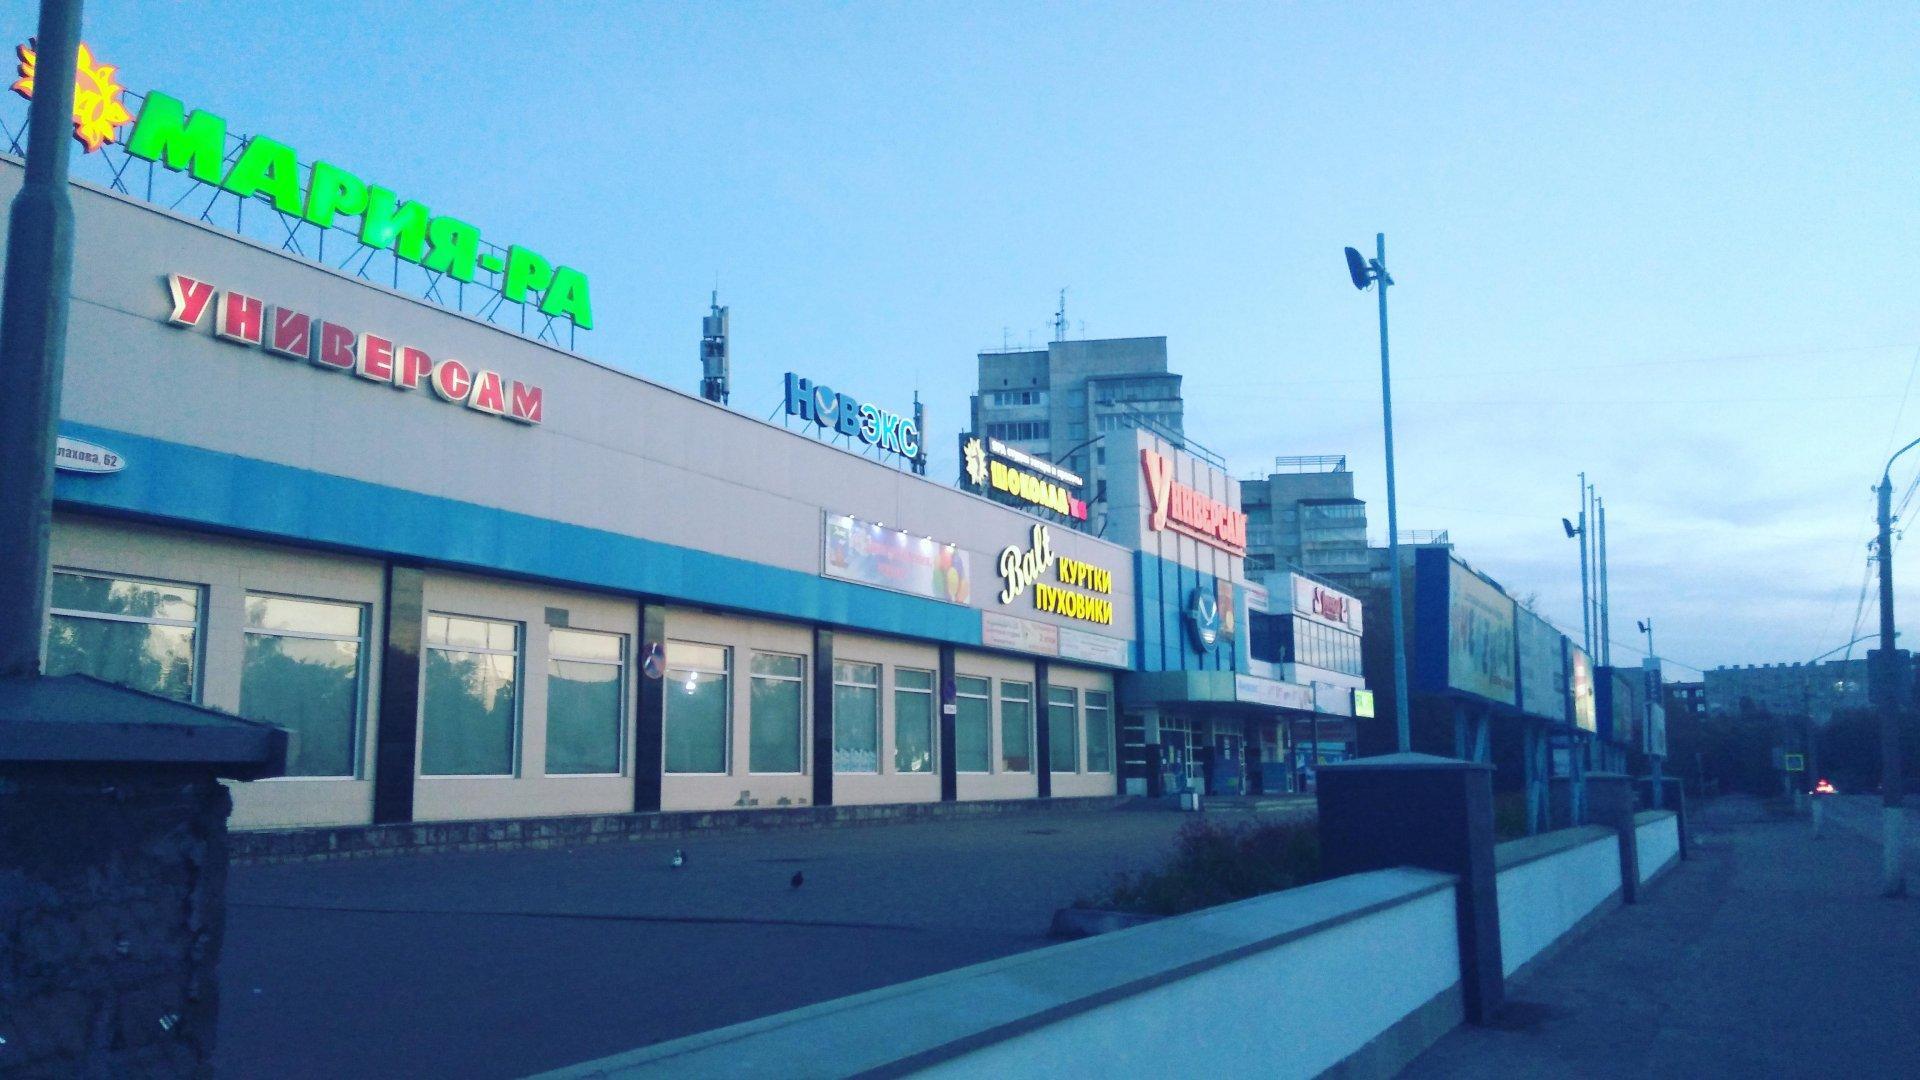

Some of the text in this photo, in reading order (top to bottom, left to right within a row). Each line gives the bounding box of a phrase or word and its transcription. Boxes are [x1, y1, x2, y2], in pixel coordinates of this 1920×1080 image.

[124, 89, 594, 331] МАРИЯ-РА
[168, 273, 543, 425] УНИВЕРСАМ
[784, 371, 918, 458] НОВЭКС
[1034, 582, 1113, 625] ПУХОВИКИ
[1058, 556, 1112, 594] КУРТКИ
